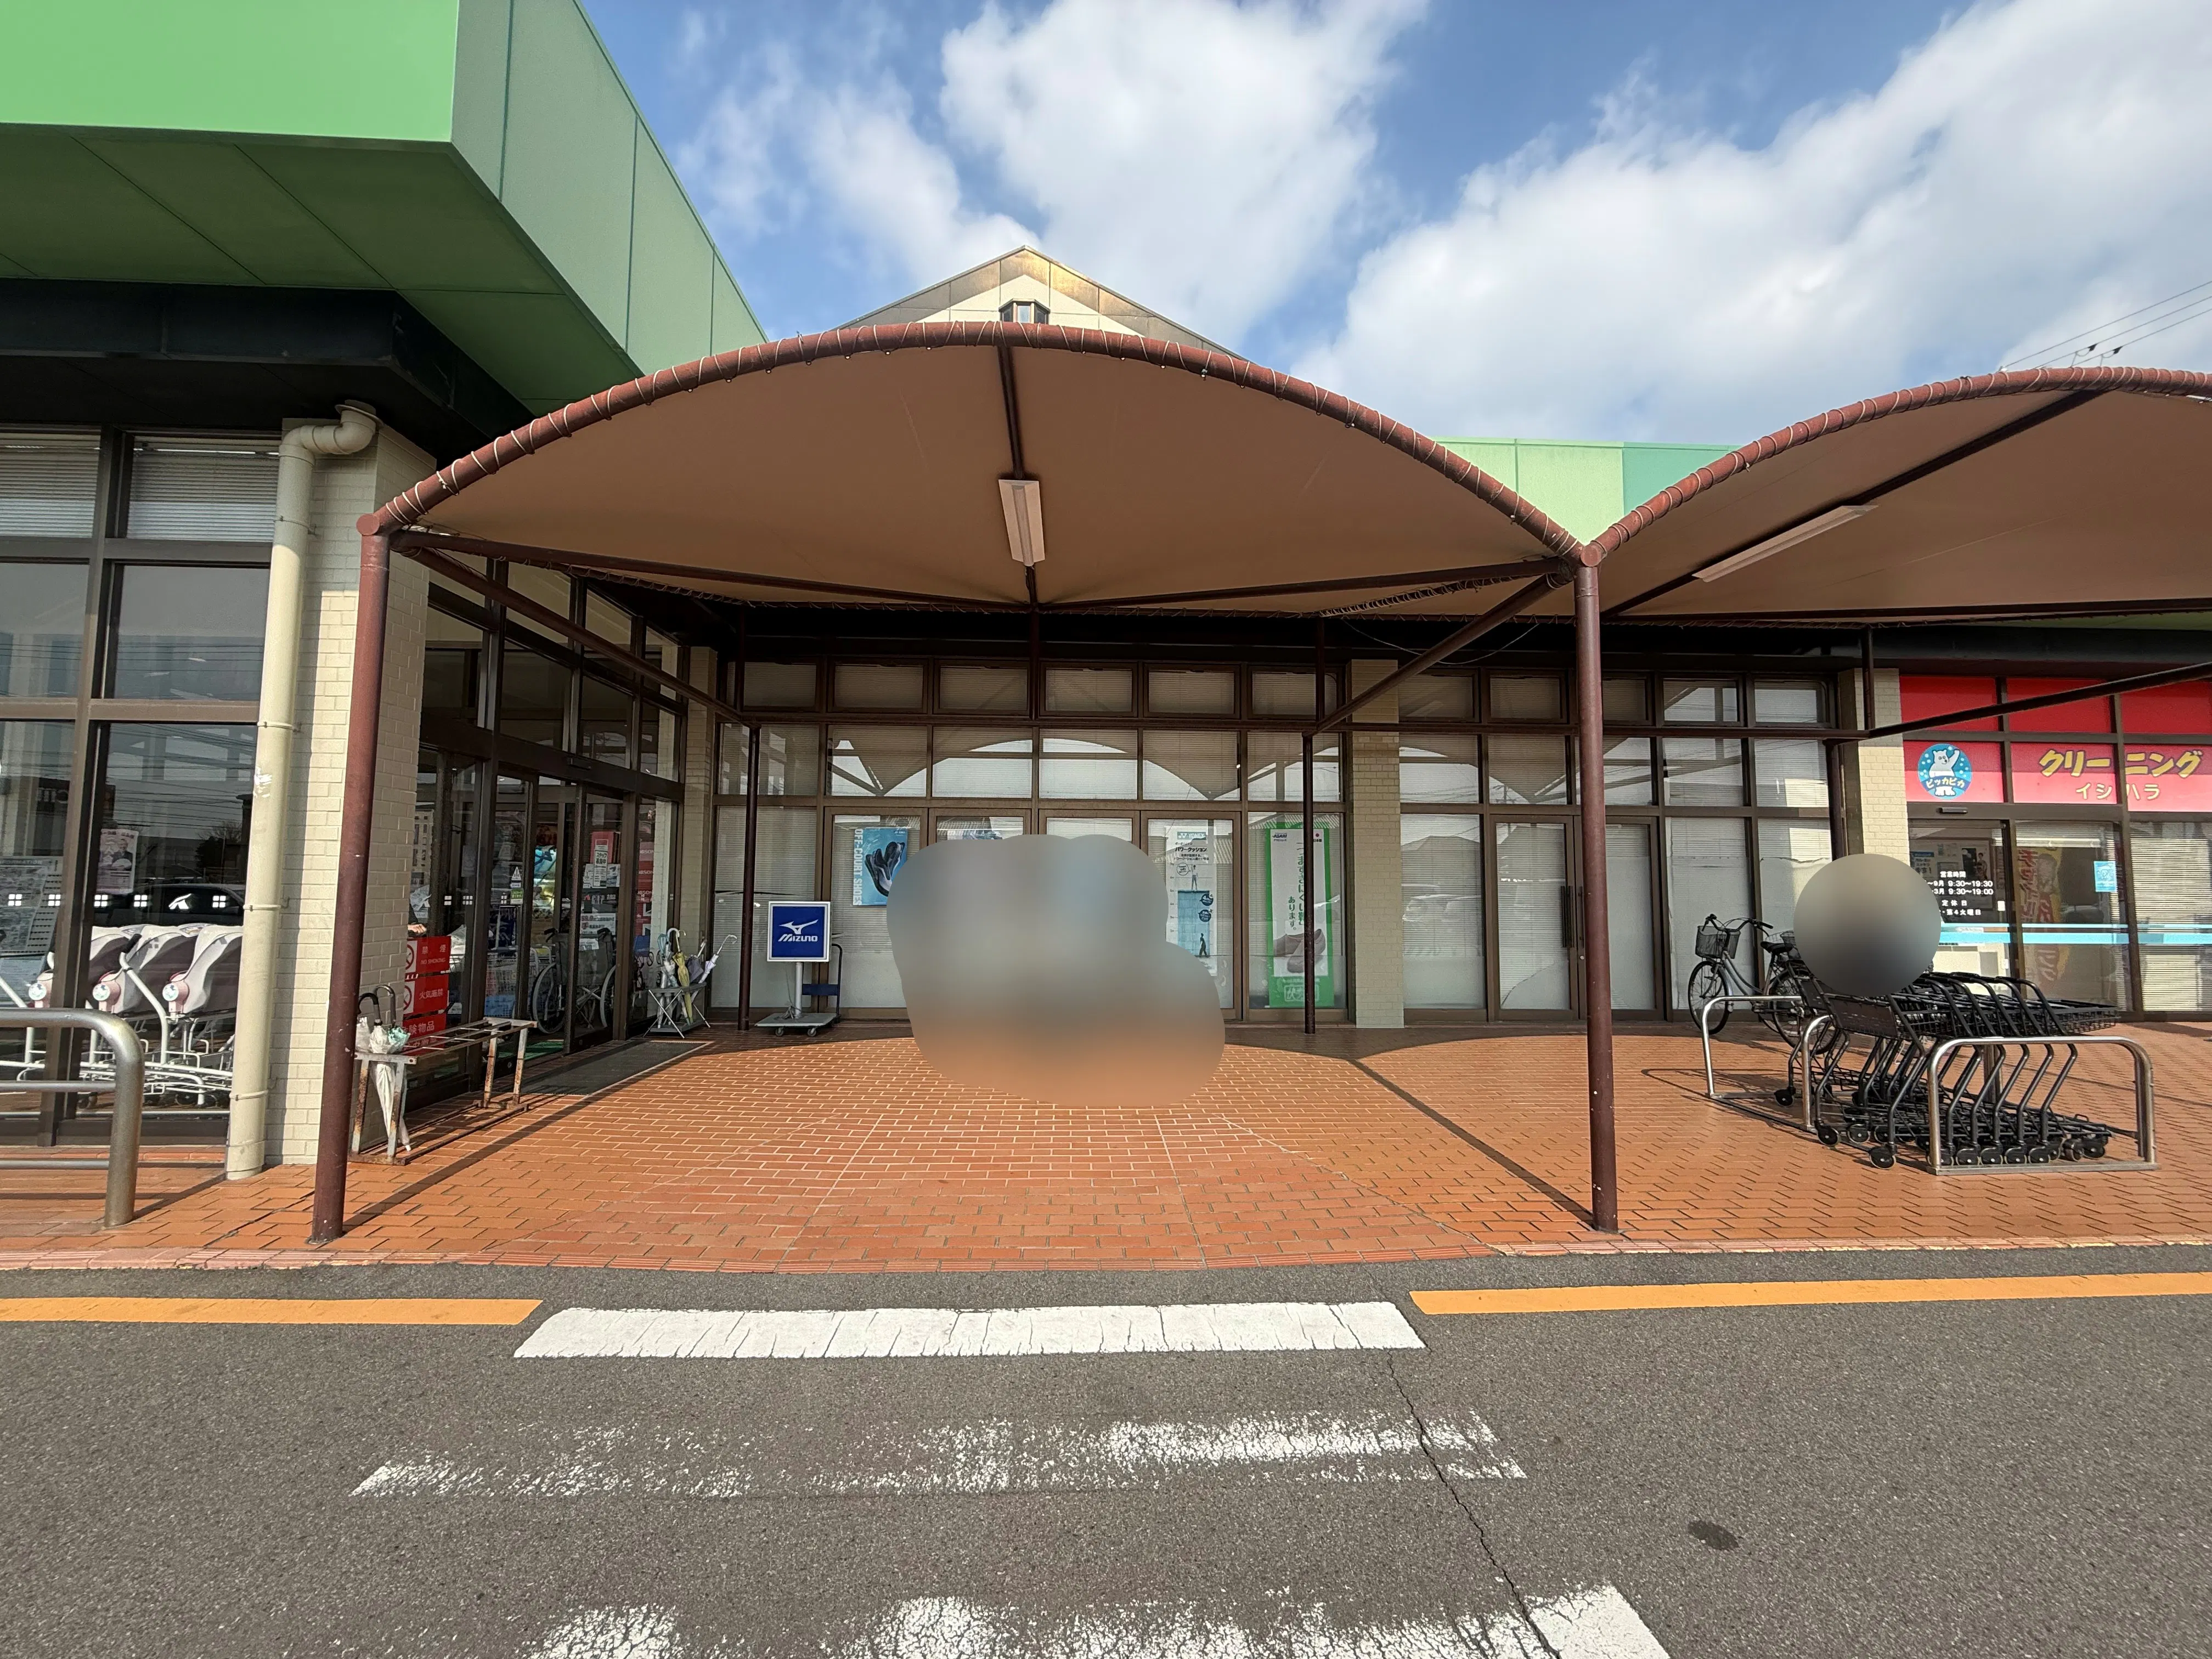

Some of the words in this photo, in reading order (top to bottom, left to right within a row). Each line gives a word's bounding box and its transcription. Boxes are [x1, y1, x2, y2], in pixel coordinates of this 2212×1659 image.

[2039, 749, 2203, 778] クリーニング
[2075, 782, 2160, 800] イシハラ
[854, 828, 864, 876] OFF-COURT
[853, 878, 862, 906] SHOES
[1288, 896, 1296, 930] あります。
